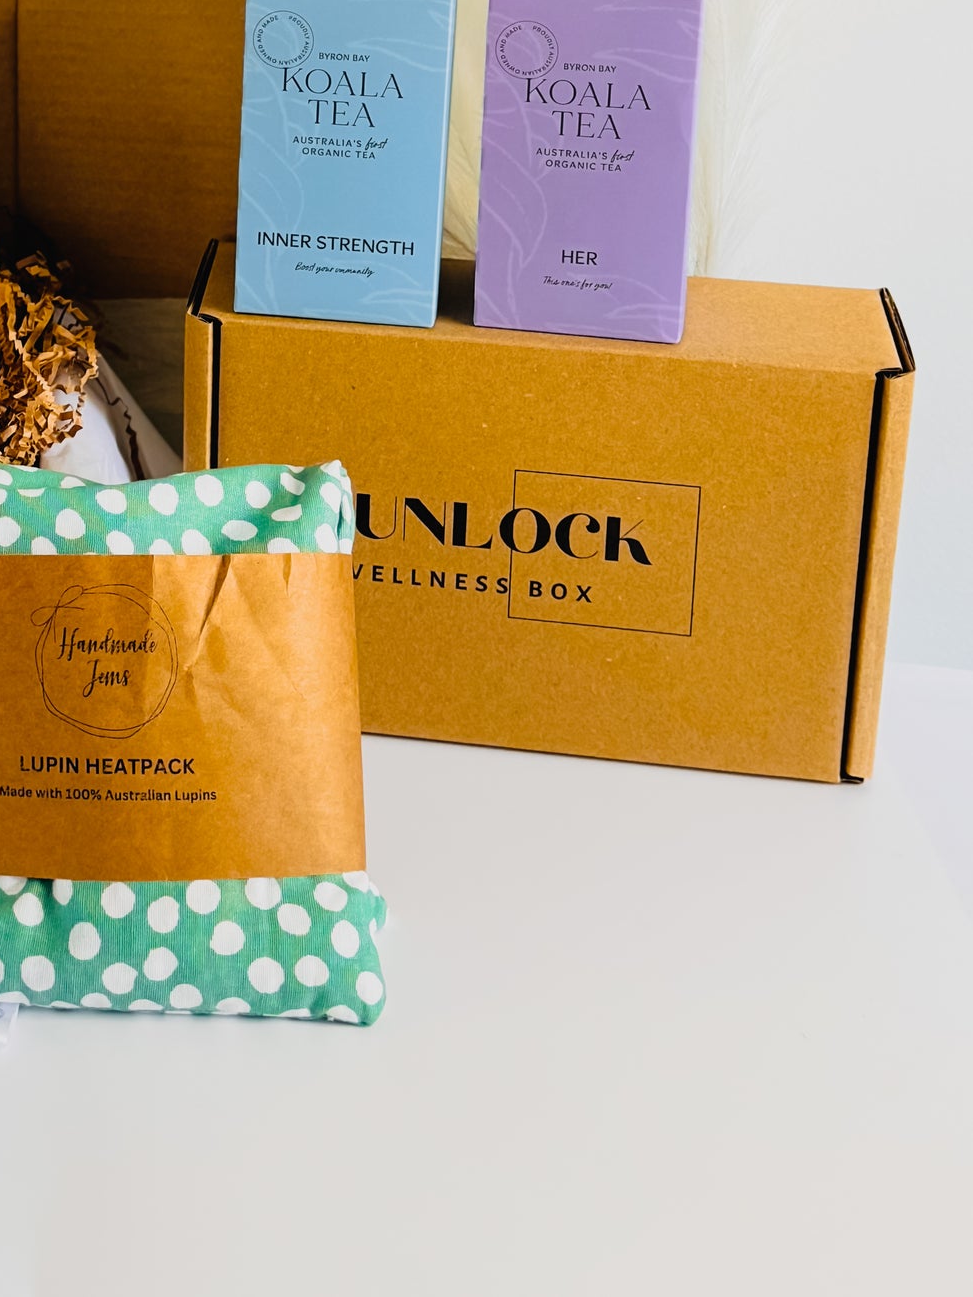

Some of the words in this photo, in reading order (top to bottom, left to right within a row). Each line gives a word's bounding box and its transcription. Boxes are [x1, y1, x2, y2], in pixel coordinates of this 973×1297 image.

[261, 15, 278, 28] MADE
[288, 15, 310, 39] PROUDLY
[505, 25, 522, 38] MADE
[499, 38, 507, 53] AND
[532, 25, 555, 50] PROUDLY
[258, 44, 277, 64] OWNED
[278, 41, 310, 66] AUSTRALIAN
[318, 52, 350, 62] BYRON
[352, 53, 371, 63] BAY
[522, 51, 555, 76] AUSTRALIAN
[500, 54, 521, 74] OWNED
[563, 62, 596, 72] BYRON
[598, 64, 617, 73] BAY
[281, 67, 404, 99] KOALA
[524, 77, 652, 111] KOALA
[307, 99, 376, 128] TEA
[551, 110, 622, 140] TEA
[292, 136, 362, 148] AUSTRALIA'S
[364, 137, 389, 150] first
[301, 147, 351, 158] ORGANIC
[355, 150, 376, 159] TEA
[536, 147, 608, 160] AUSTRALIA'S
[610, 149, 635, 162] first
[545, 159, 596, 170] ORGANIC
[600, 163, 622, 172] TEA
[257, 231, 312, 249] INNER
[316, 235, 415, 255] STRENGTH
[561, 249, 598, 266] HER
[295, 262, 316, 271] Boost
[315, 266, 334, 274] your
[543, 275, 560, 285] This
[580, 279, 594, 290] for
[355, 492, 653, 566] UNLOCK
[528, 580, 593, 604] BOX
[57, 626, 158, 662] Handmade
[82, 659, 132, 698] Jems
[19, 755, 79, 774] LUPIN
[85, 758, 196, 775] HEATPACK
[35, 787, 63, 799] with
[65, 788, 102, 800] 100%
[105, 789, 171, 802] Australian
[174, 788, 217, 804] Lupins
